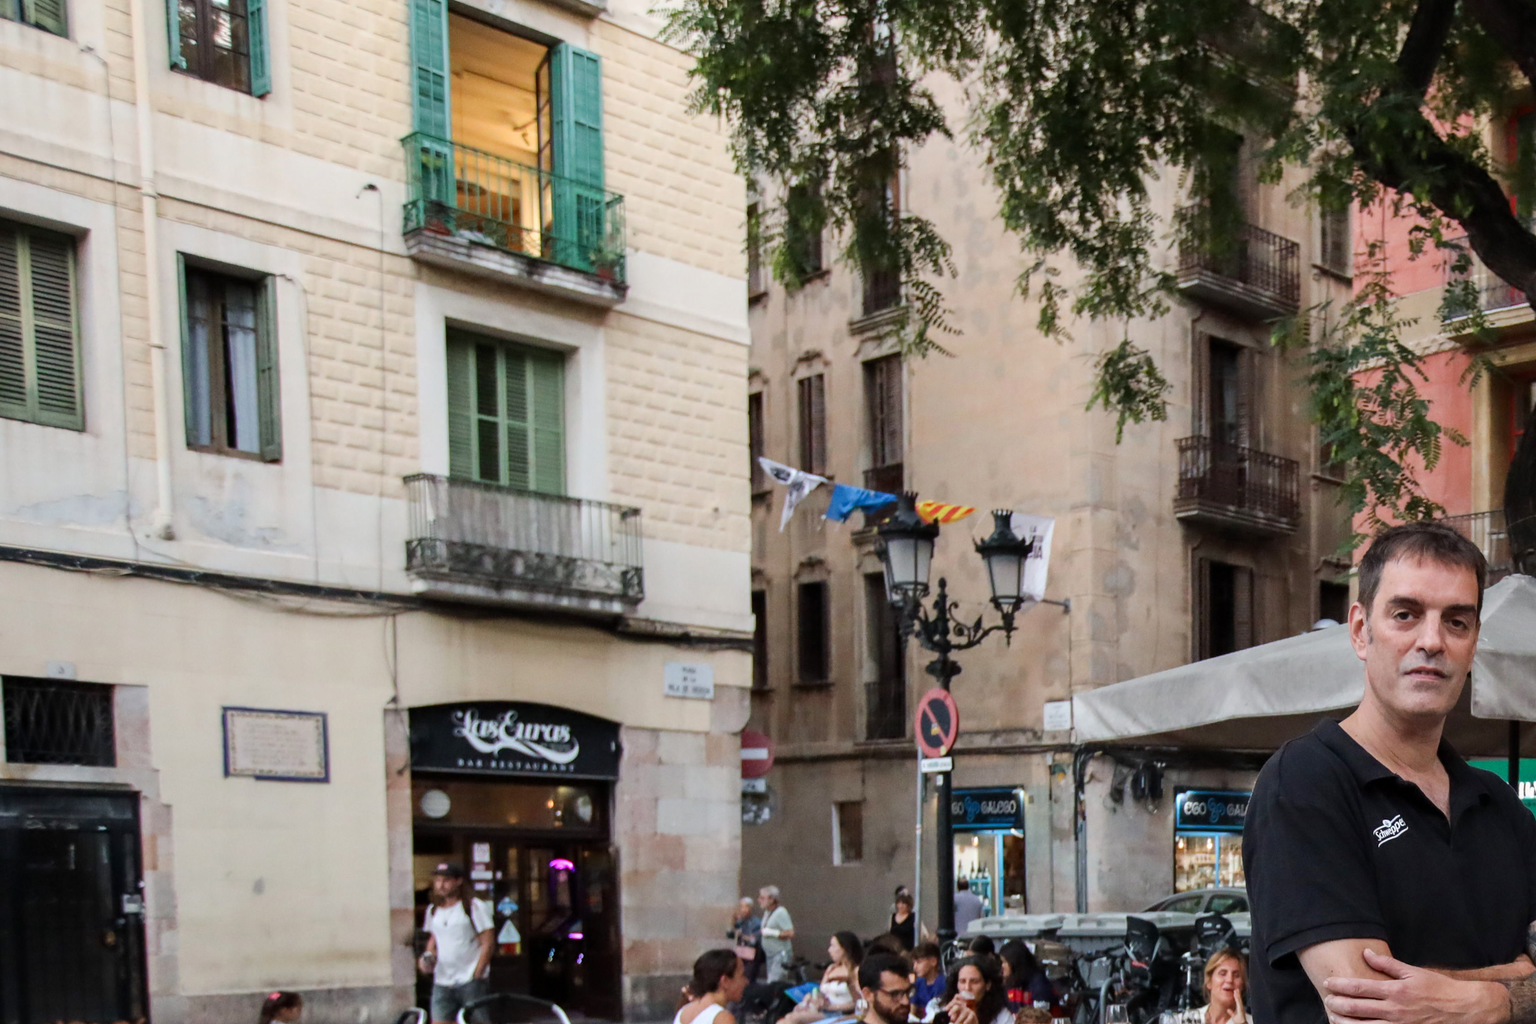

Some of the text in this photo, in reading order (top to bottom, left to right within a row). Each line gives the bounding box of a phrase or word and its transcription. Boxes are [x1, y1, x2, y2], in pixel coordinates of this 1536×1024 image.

[452, 709, 575, 750] Las Euras
[457, 757, 483, 768] BAR
[1375, 817, 1407, 842] Schweppe
